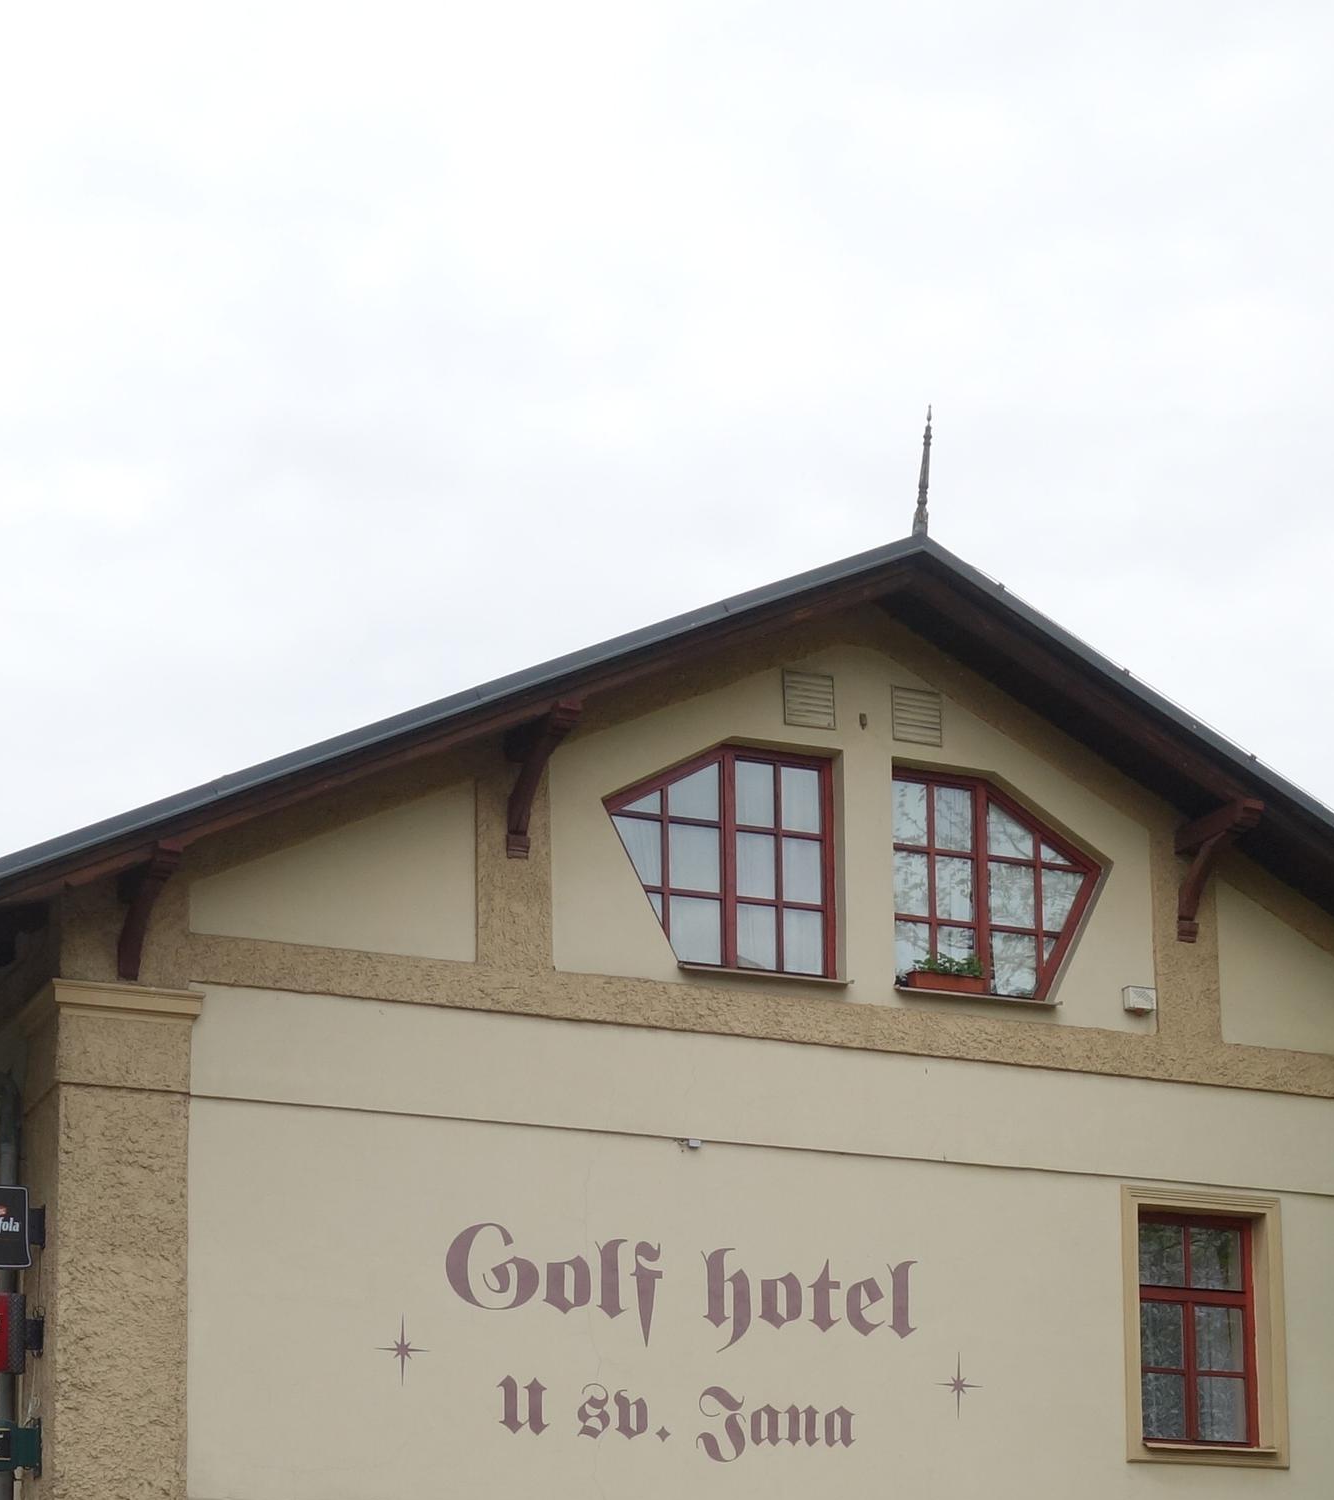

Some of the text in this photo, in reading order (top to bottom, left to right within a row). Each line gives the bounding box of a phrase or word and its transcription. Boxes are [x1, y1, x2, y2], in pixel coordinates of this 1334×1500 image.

[445, 1222, 663, 1348] Golf
[576, 1382, 671, 1441] sv.
[695, 1385, 857, 1463] Jana
